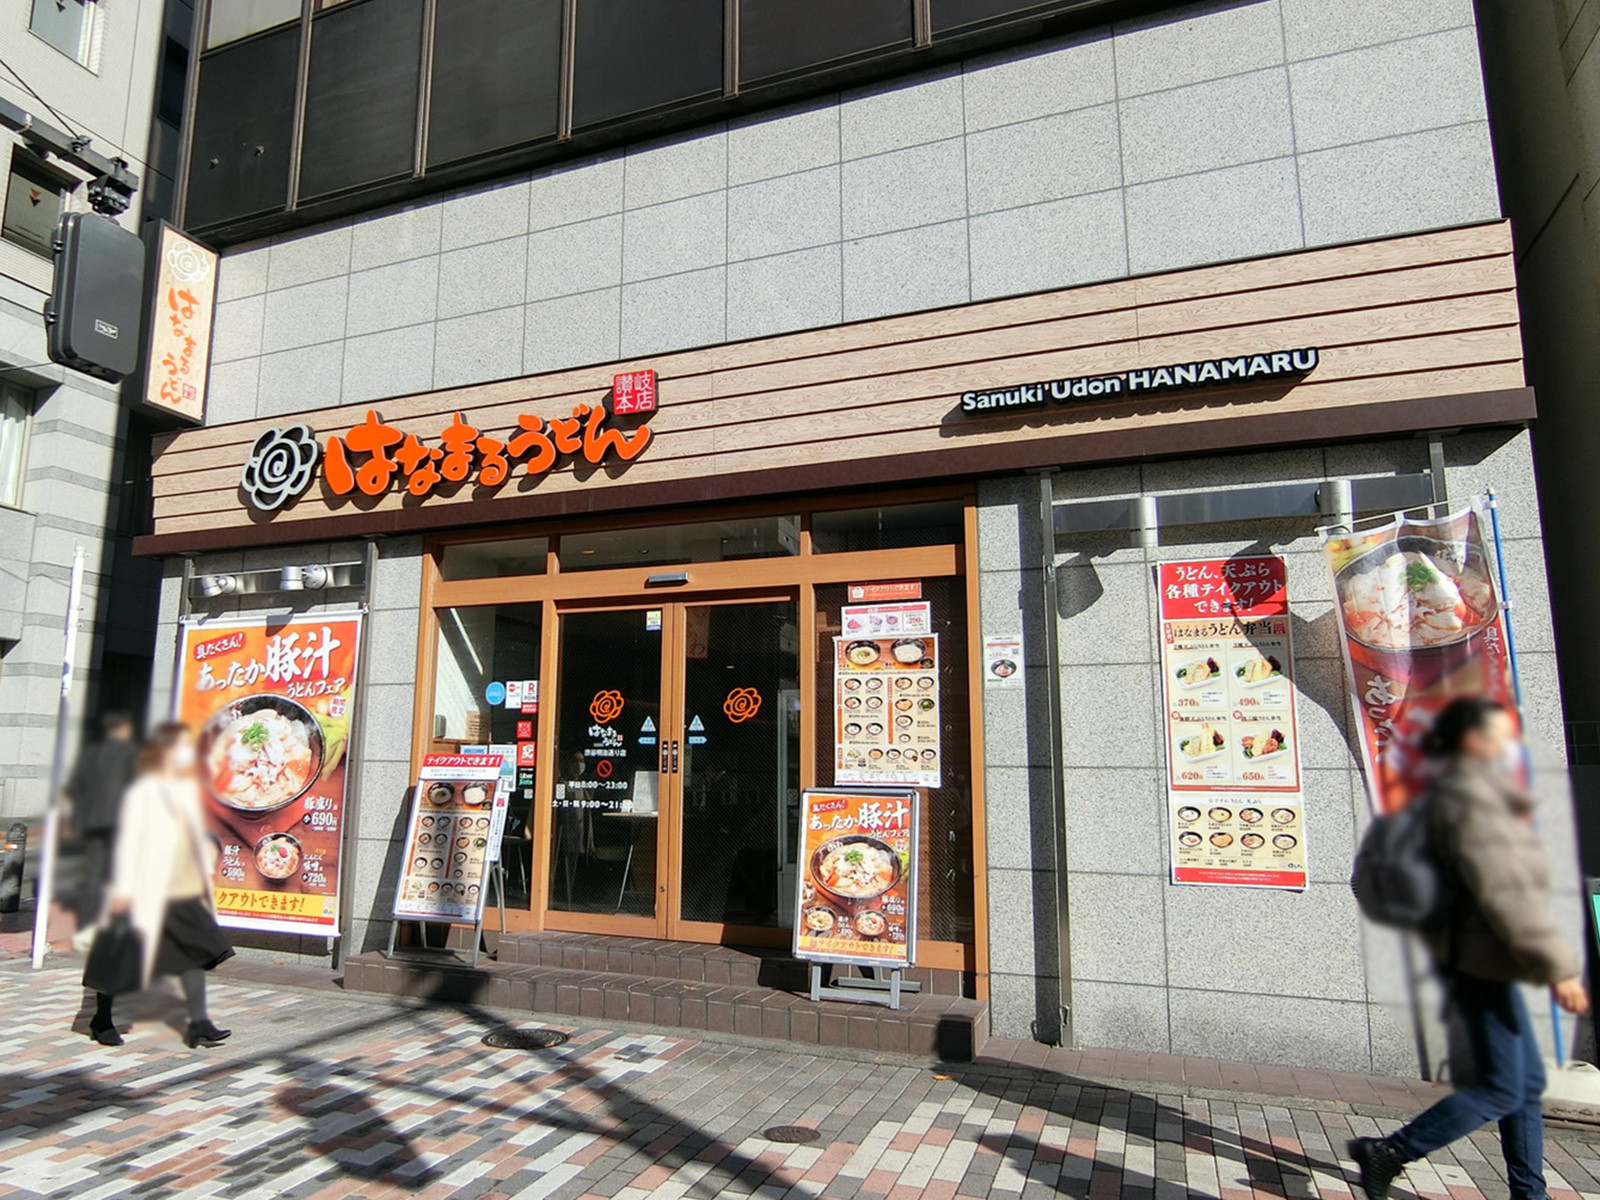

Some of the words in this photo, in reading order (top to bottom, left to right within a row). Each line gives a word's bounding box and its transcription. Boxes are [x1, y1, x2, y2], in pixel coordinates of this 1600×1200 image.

[962, 384, 1043, 411] Sanuki
[1051, 377, 1121, 400] Udon
[1128, 348, 1319, 391] HANAMARU
[325, 409, 650, 496] はなまるうどん
[1175, 563, 1270, 581] うどん、天ぷら
[1166, 579, 1282, 599] 各種テイクアウト
[1194, 598, 1254, 613] できます！
[1174, 621, 1272, 637] はなまるうどん弁当
[286, 677, 346, 698] うどんフェア
[427, 756, 500, 766] テイクアウトできます！
[809, 801, 909, 830] あったか豚汁
[218, 891, 305, 913] クアウトできます！
